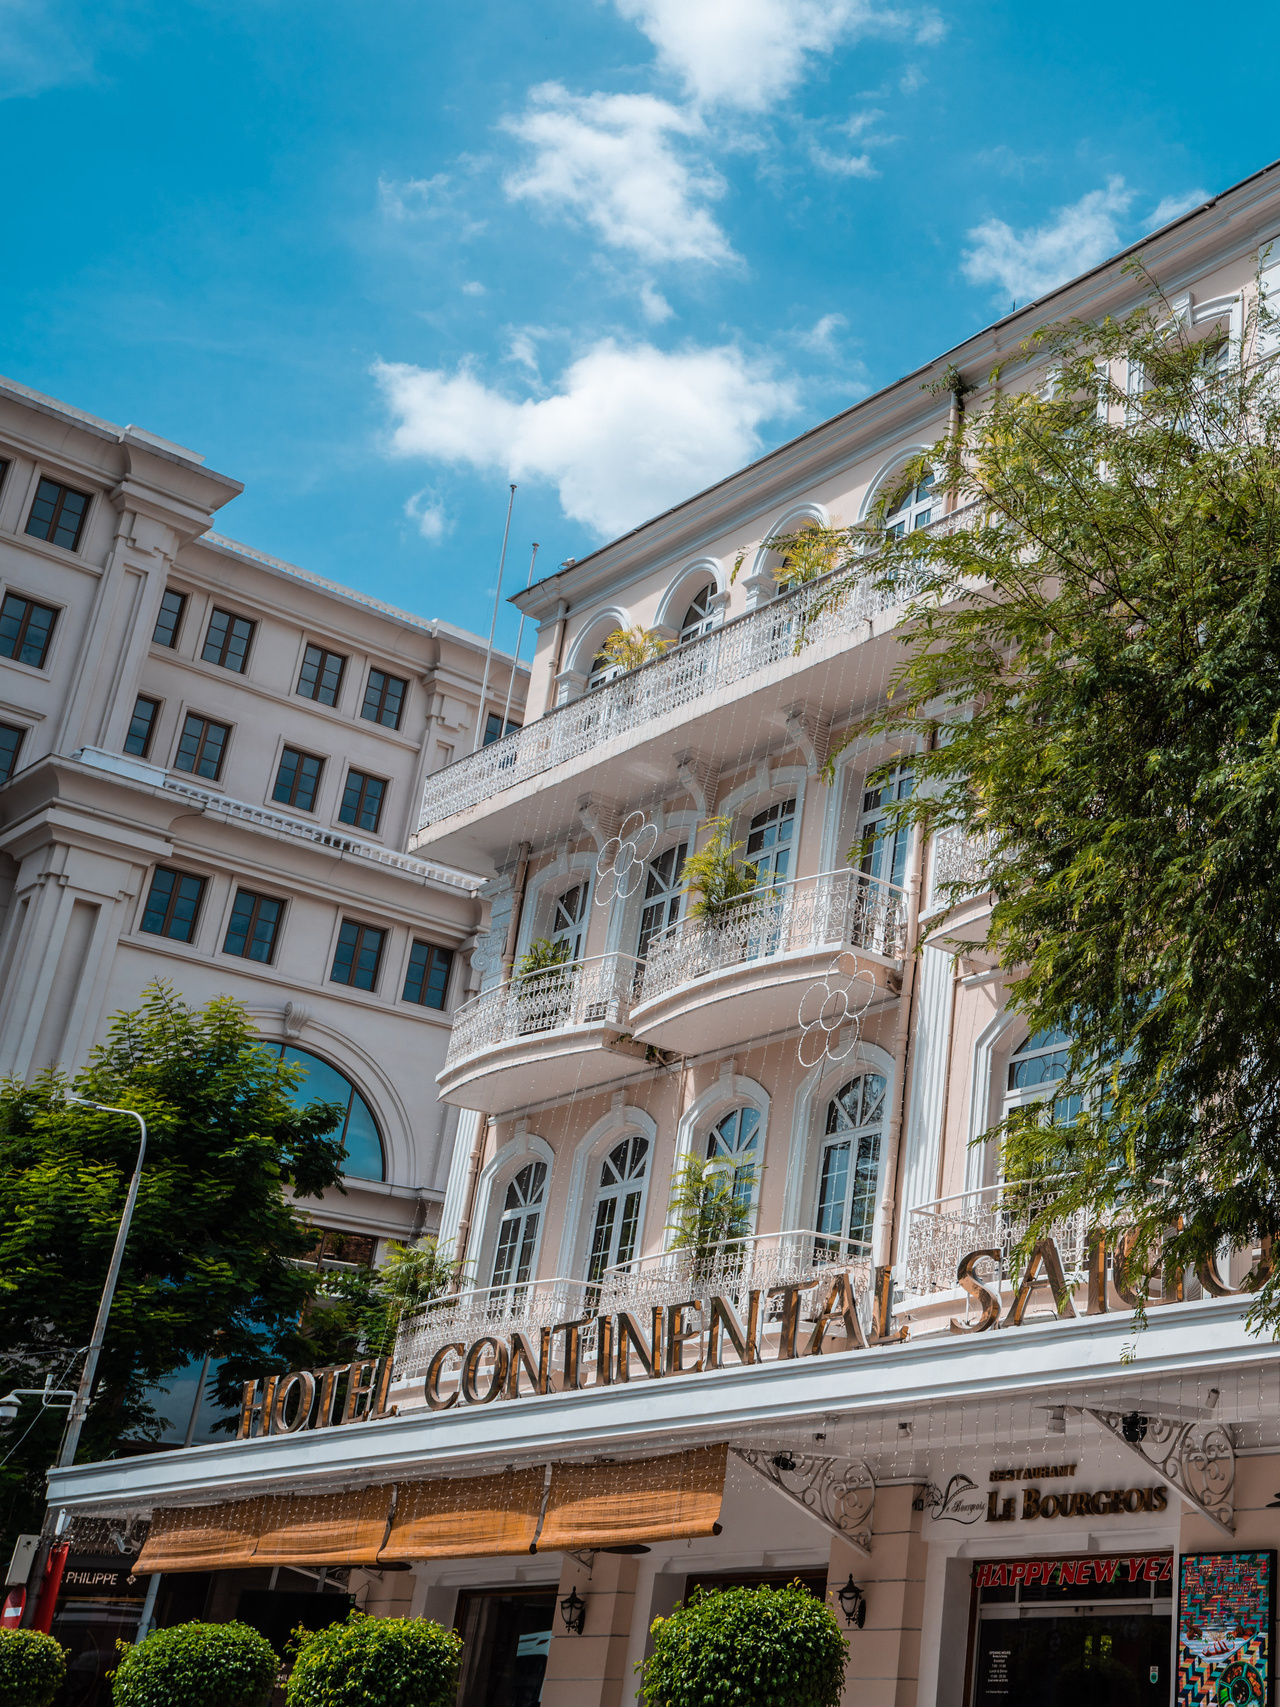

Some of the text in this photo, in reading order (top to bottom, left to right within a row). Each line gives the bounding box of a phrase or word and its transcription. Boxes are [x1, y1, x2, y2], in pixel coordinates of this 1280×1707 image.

[236, 1356, 400, 1440] HOTEL
[423, 1264, 910, 1412] CONTINENTAL
[988, 1464, 1078, 1482] RESTAURANT
[985, 1485, 1169, 1523] LE BOURGEOIS
[65, 1571, 119, 1586] PHILIPPE
[976, 1555, 1174, 1588] HAPPY NEW YEA
